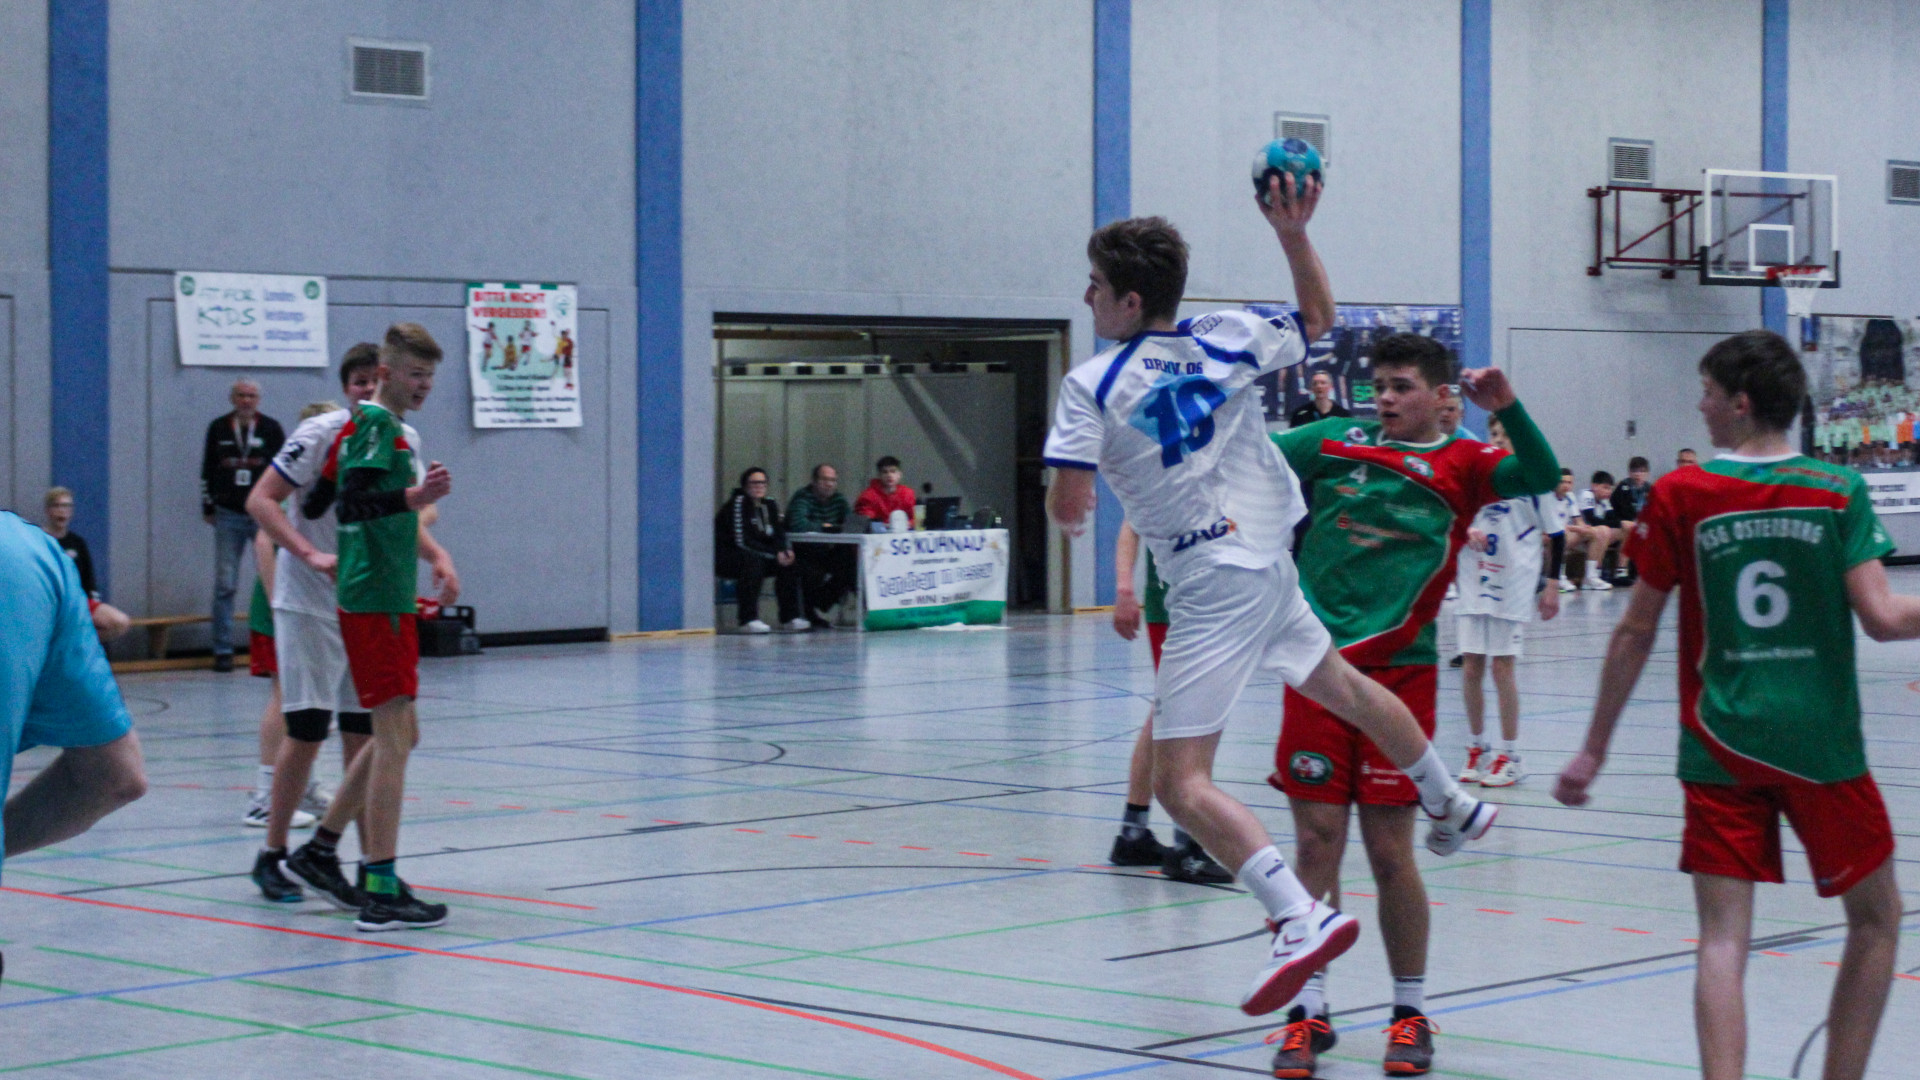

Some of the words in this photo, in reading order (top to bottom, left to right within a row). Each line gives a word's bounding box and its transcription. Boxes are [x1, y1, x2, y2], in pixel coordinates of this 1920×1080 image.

[1142, 358, 1180, 374] DRHV
[1348, 464, 1369, 484] 4
[889, 538, 911, 556] SG
[1736, 560, 1790, 628] 6
